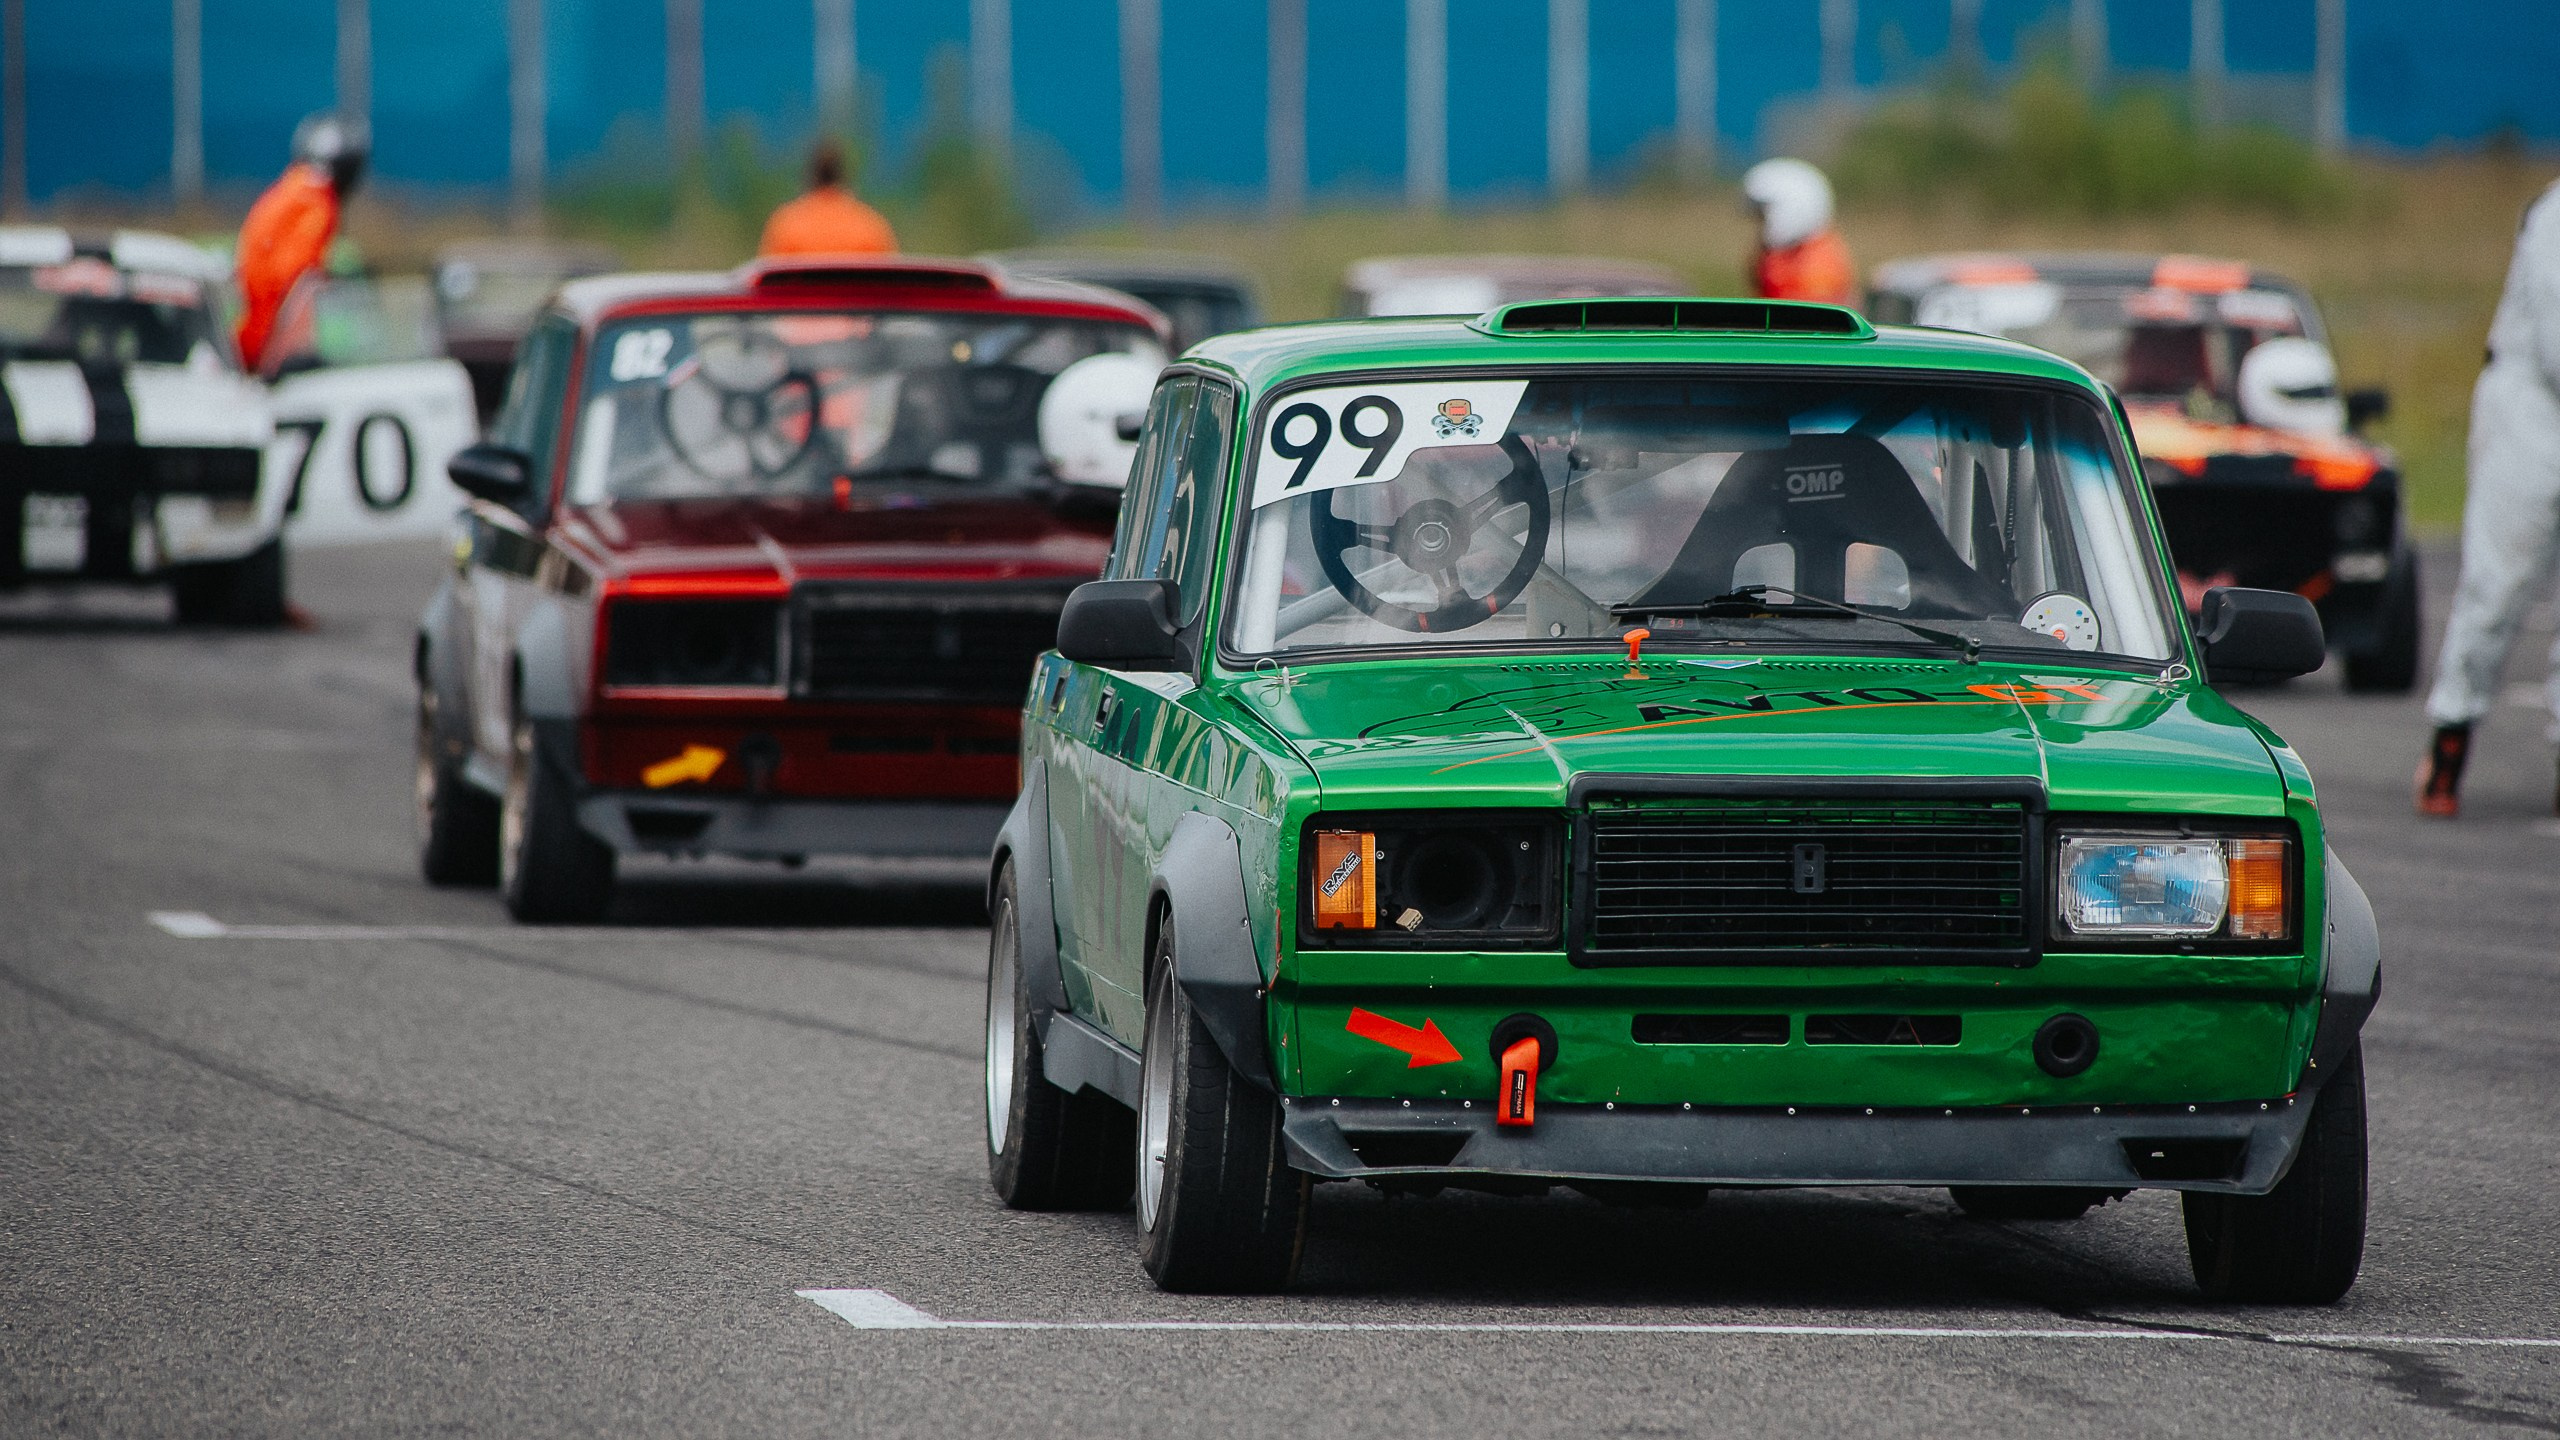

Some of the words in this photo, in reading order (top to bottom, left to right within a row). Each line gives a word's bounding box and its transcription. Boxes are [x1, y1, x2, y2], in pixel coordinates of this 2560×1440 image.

[274, 414, 414, 514] 70
[1271, 395, 1404, 490] 99
[1786, 470, 1844, 495] OMP
[1321, 851, 1358, 894] RAYS
